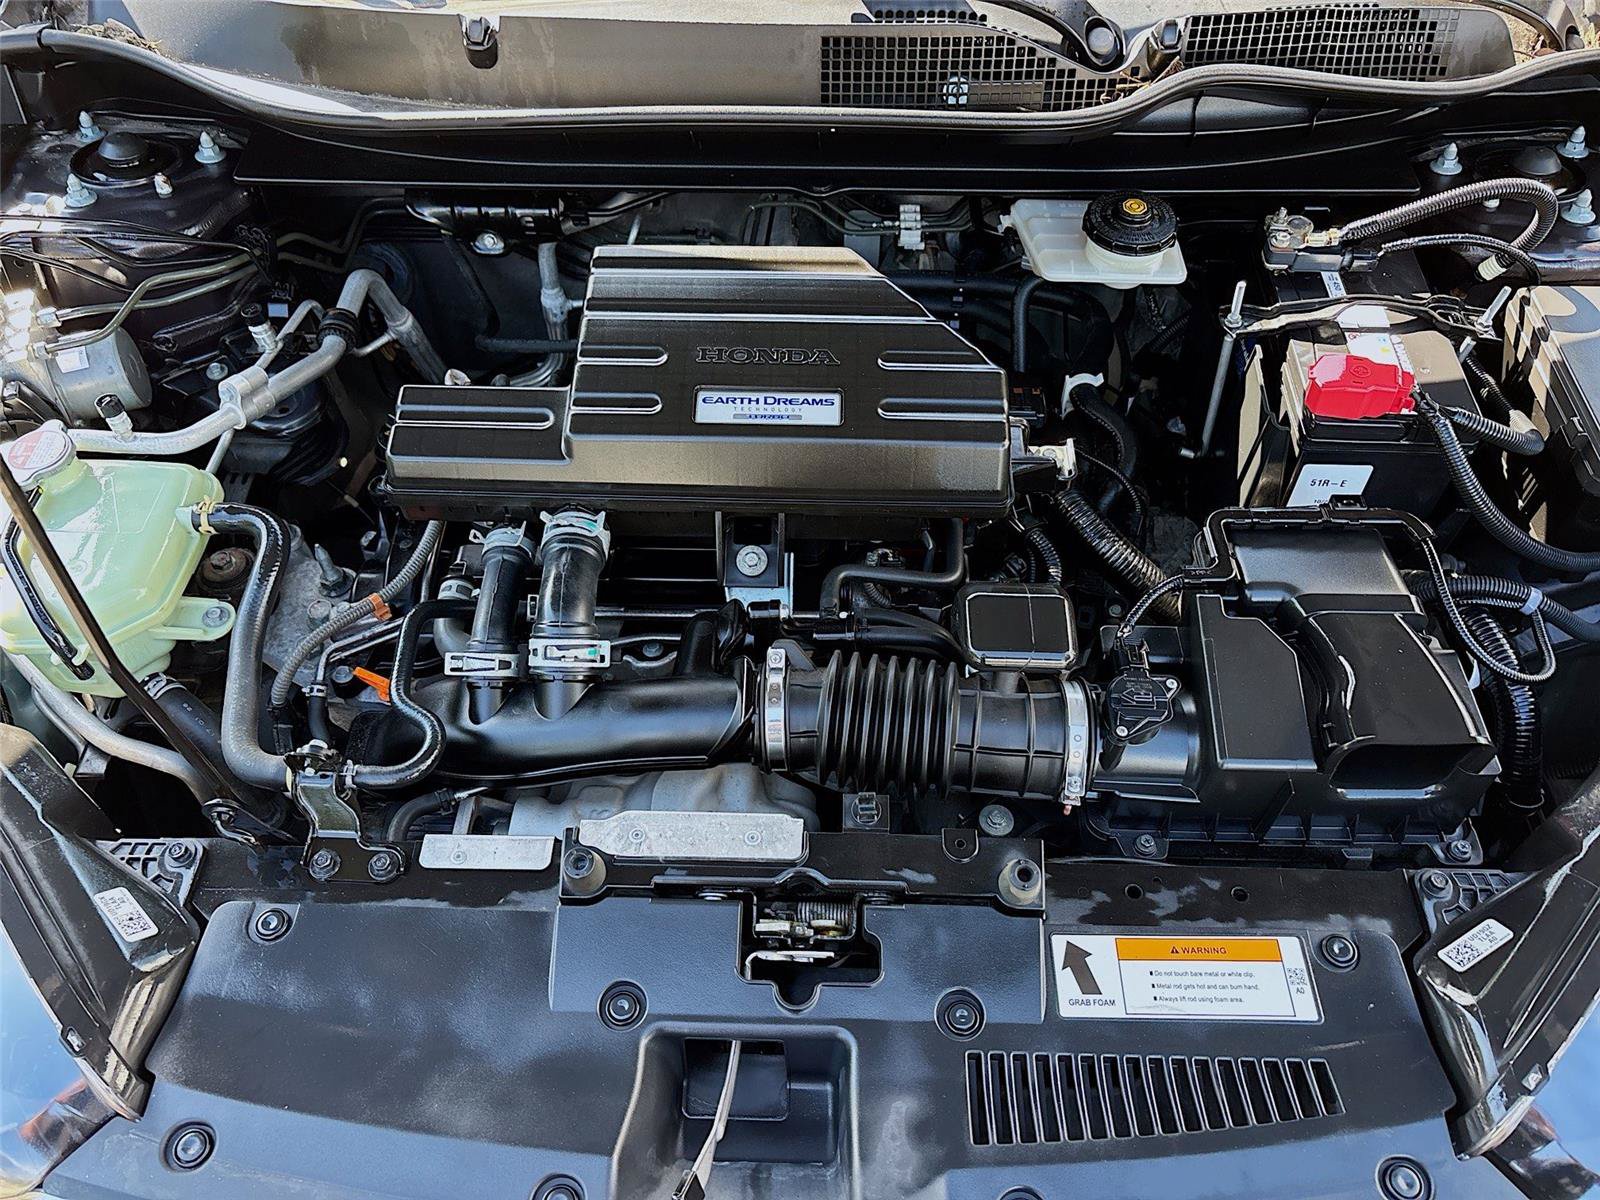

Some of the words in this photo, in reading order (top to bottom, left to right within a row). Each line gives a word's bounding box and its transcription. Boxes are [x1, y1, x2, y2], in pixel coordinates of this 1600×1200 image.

[696, 346, 840, 365] HONDA
[702, 396, 760, 405] EARTH
[763, 396, 835, 406] DREAMS
[1181, 946, 1227, 954] WARNING
[1068, 998, 1092, 1007] GRAB
[1093, 998, 1116, 1007] FOAM
[1159, 995, 1178, 1003] Always
[1198, 996, 1213, 1004] using
